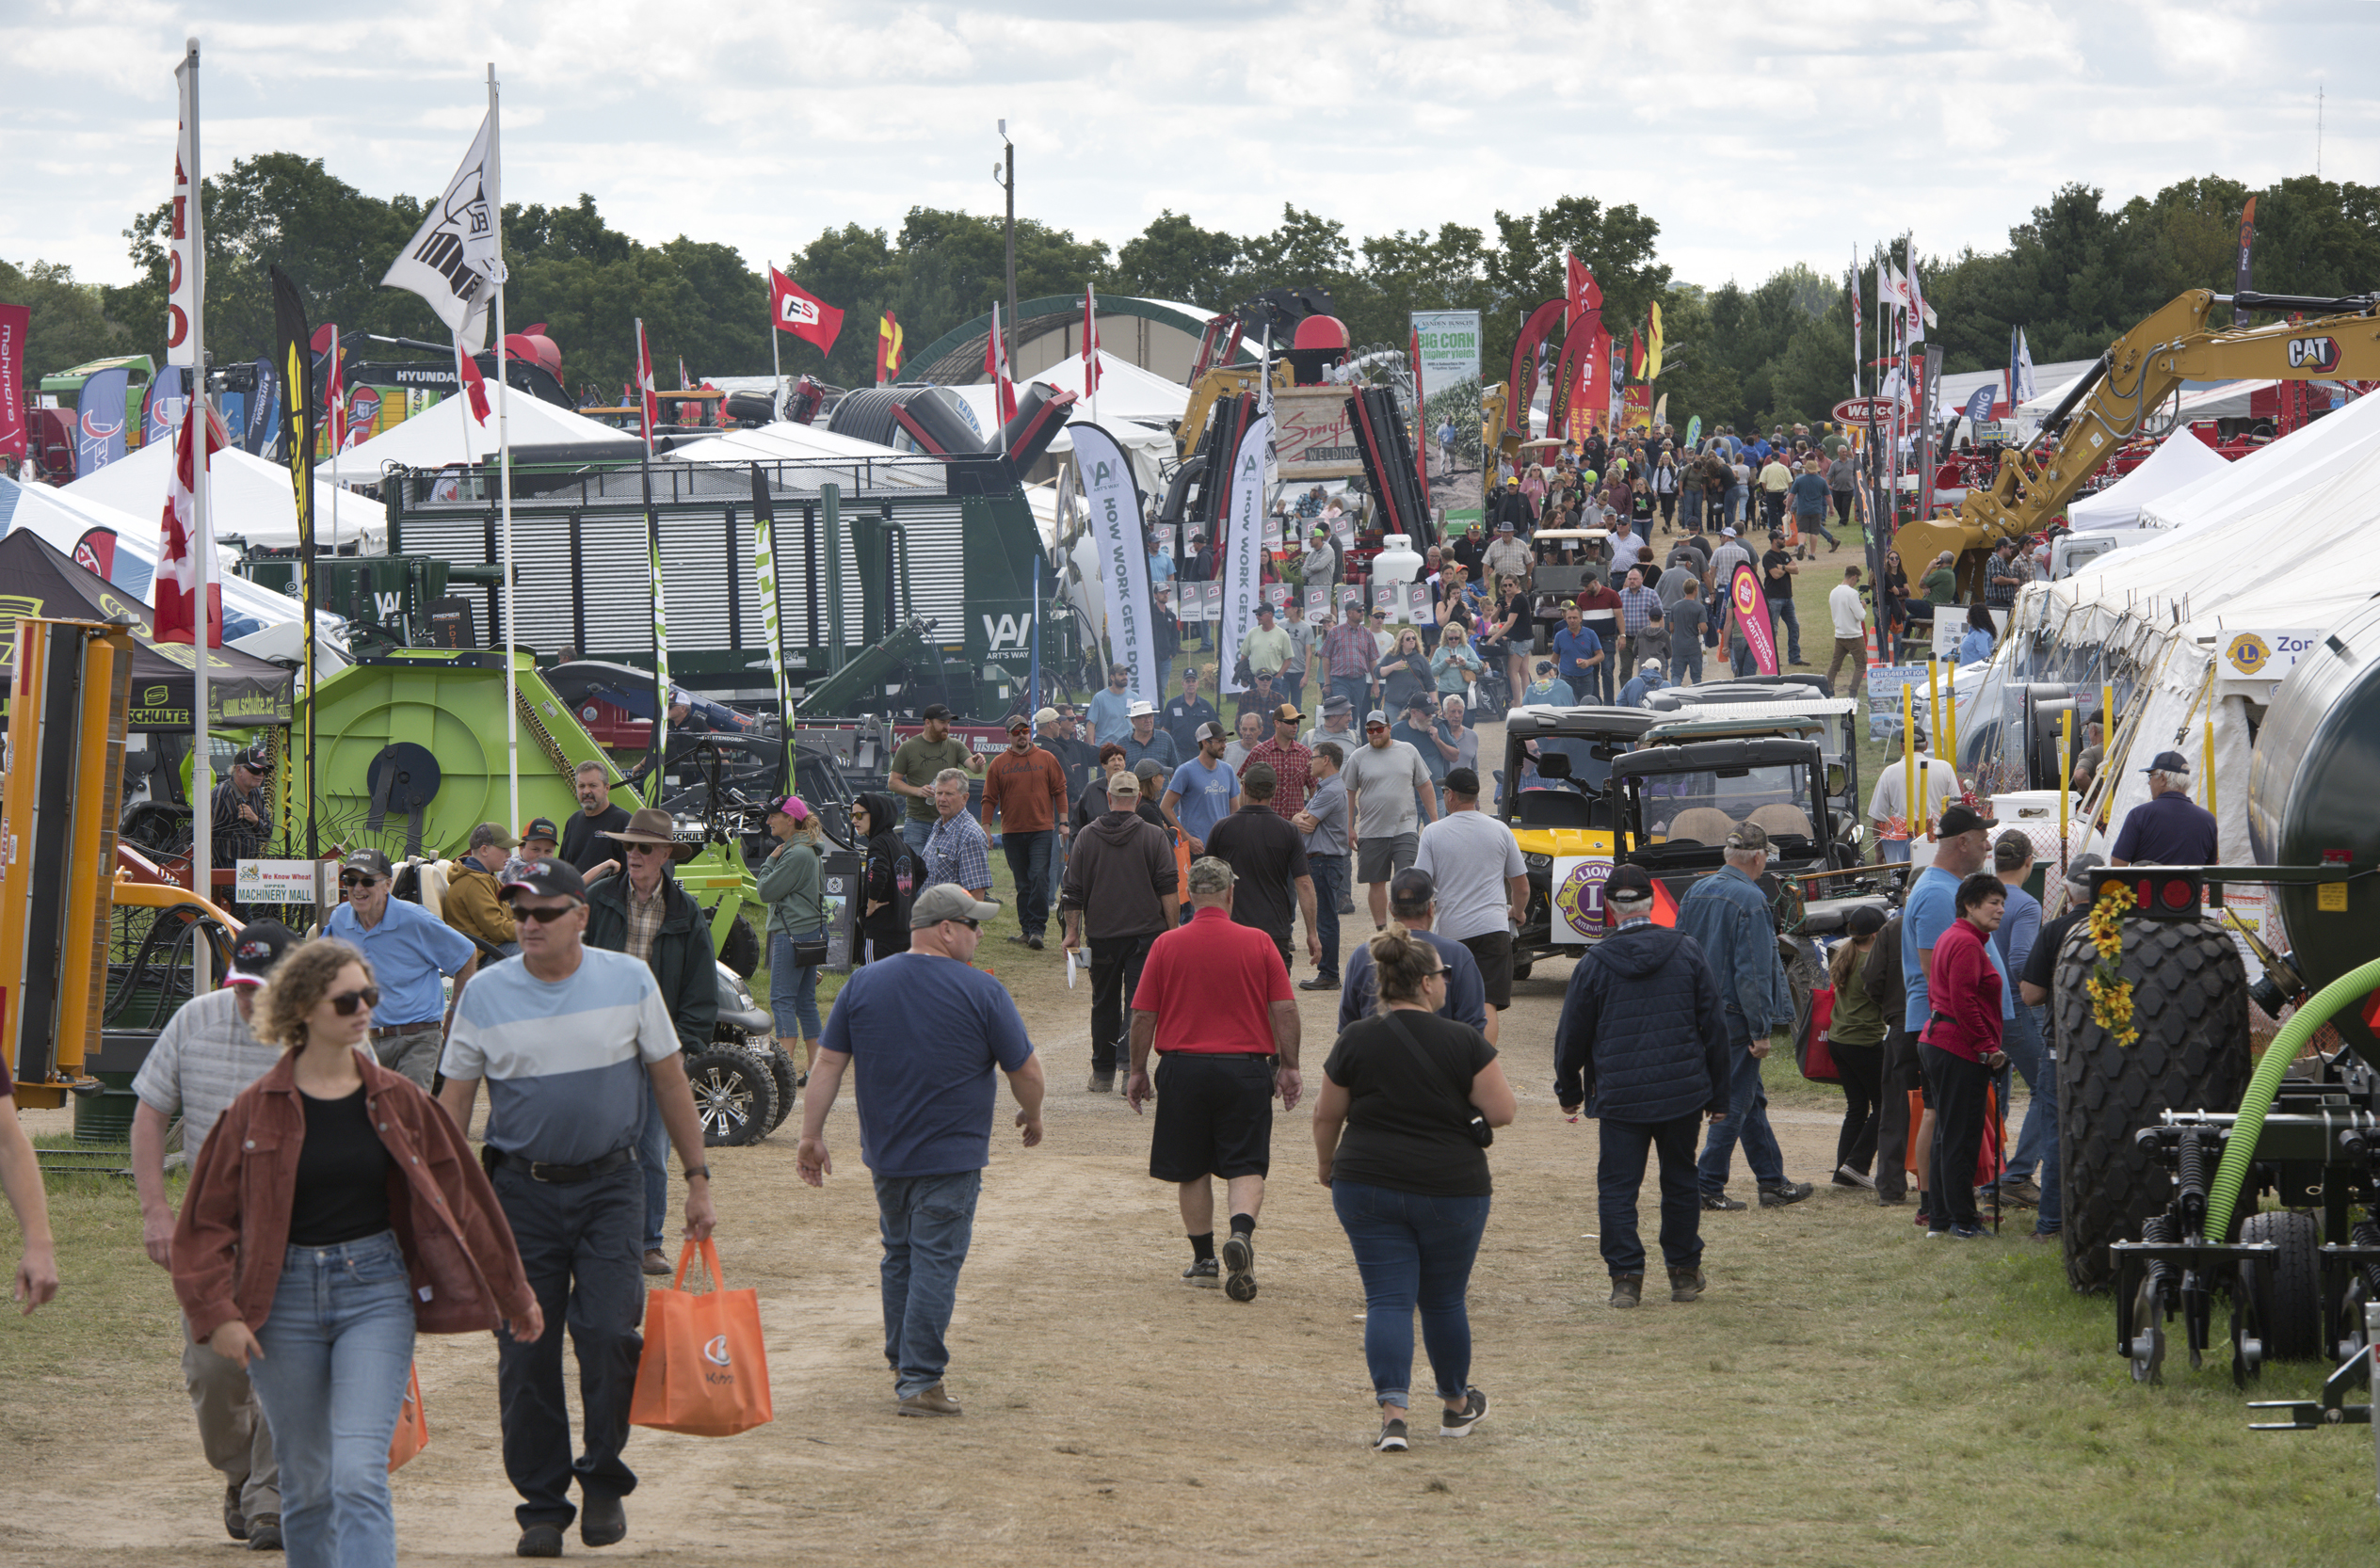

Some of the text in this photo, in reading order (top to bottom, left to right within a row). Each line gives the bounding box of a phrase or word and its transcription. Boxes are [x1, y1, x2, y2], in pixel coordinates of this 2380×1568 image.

[787, 300, 813, 318] FS
[1419, 332, 1474, 348] BIG CORN
[1423, 349, 1475, 360] higher yields
[2289, 338, 2327, 367] CAT
[255, 382, 270, 425] HYUNDAI
[958, 399, 978, 431] BAUER
[1309, 448, 1361, 460] WELDING
[1243, 489, 1253, 518] HOW
[1239, 537, 1251, 589] WORK
[1104, 498, 1121, 540] HOW
[1114, 546, 1130, 600] WORK
[1122, 605, 1136, 648] GETS
[1238, 594, 1249, 634] GETS
[1872, 669, 1926, 678] REFRIGERATION
[222, 690, 275, 718] www.schulte.ca
[672, 833, 705, 841] SCHULT
[350, 852, 372, 862] Jeep
[1578, 866, 1612, 881] LION
[238, 889, 312, 901] MACHINERY MALL
